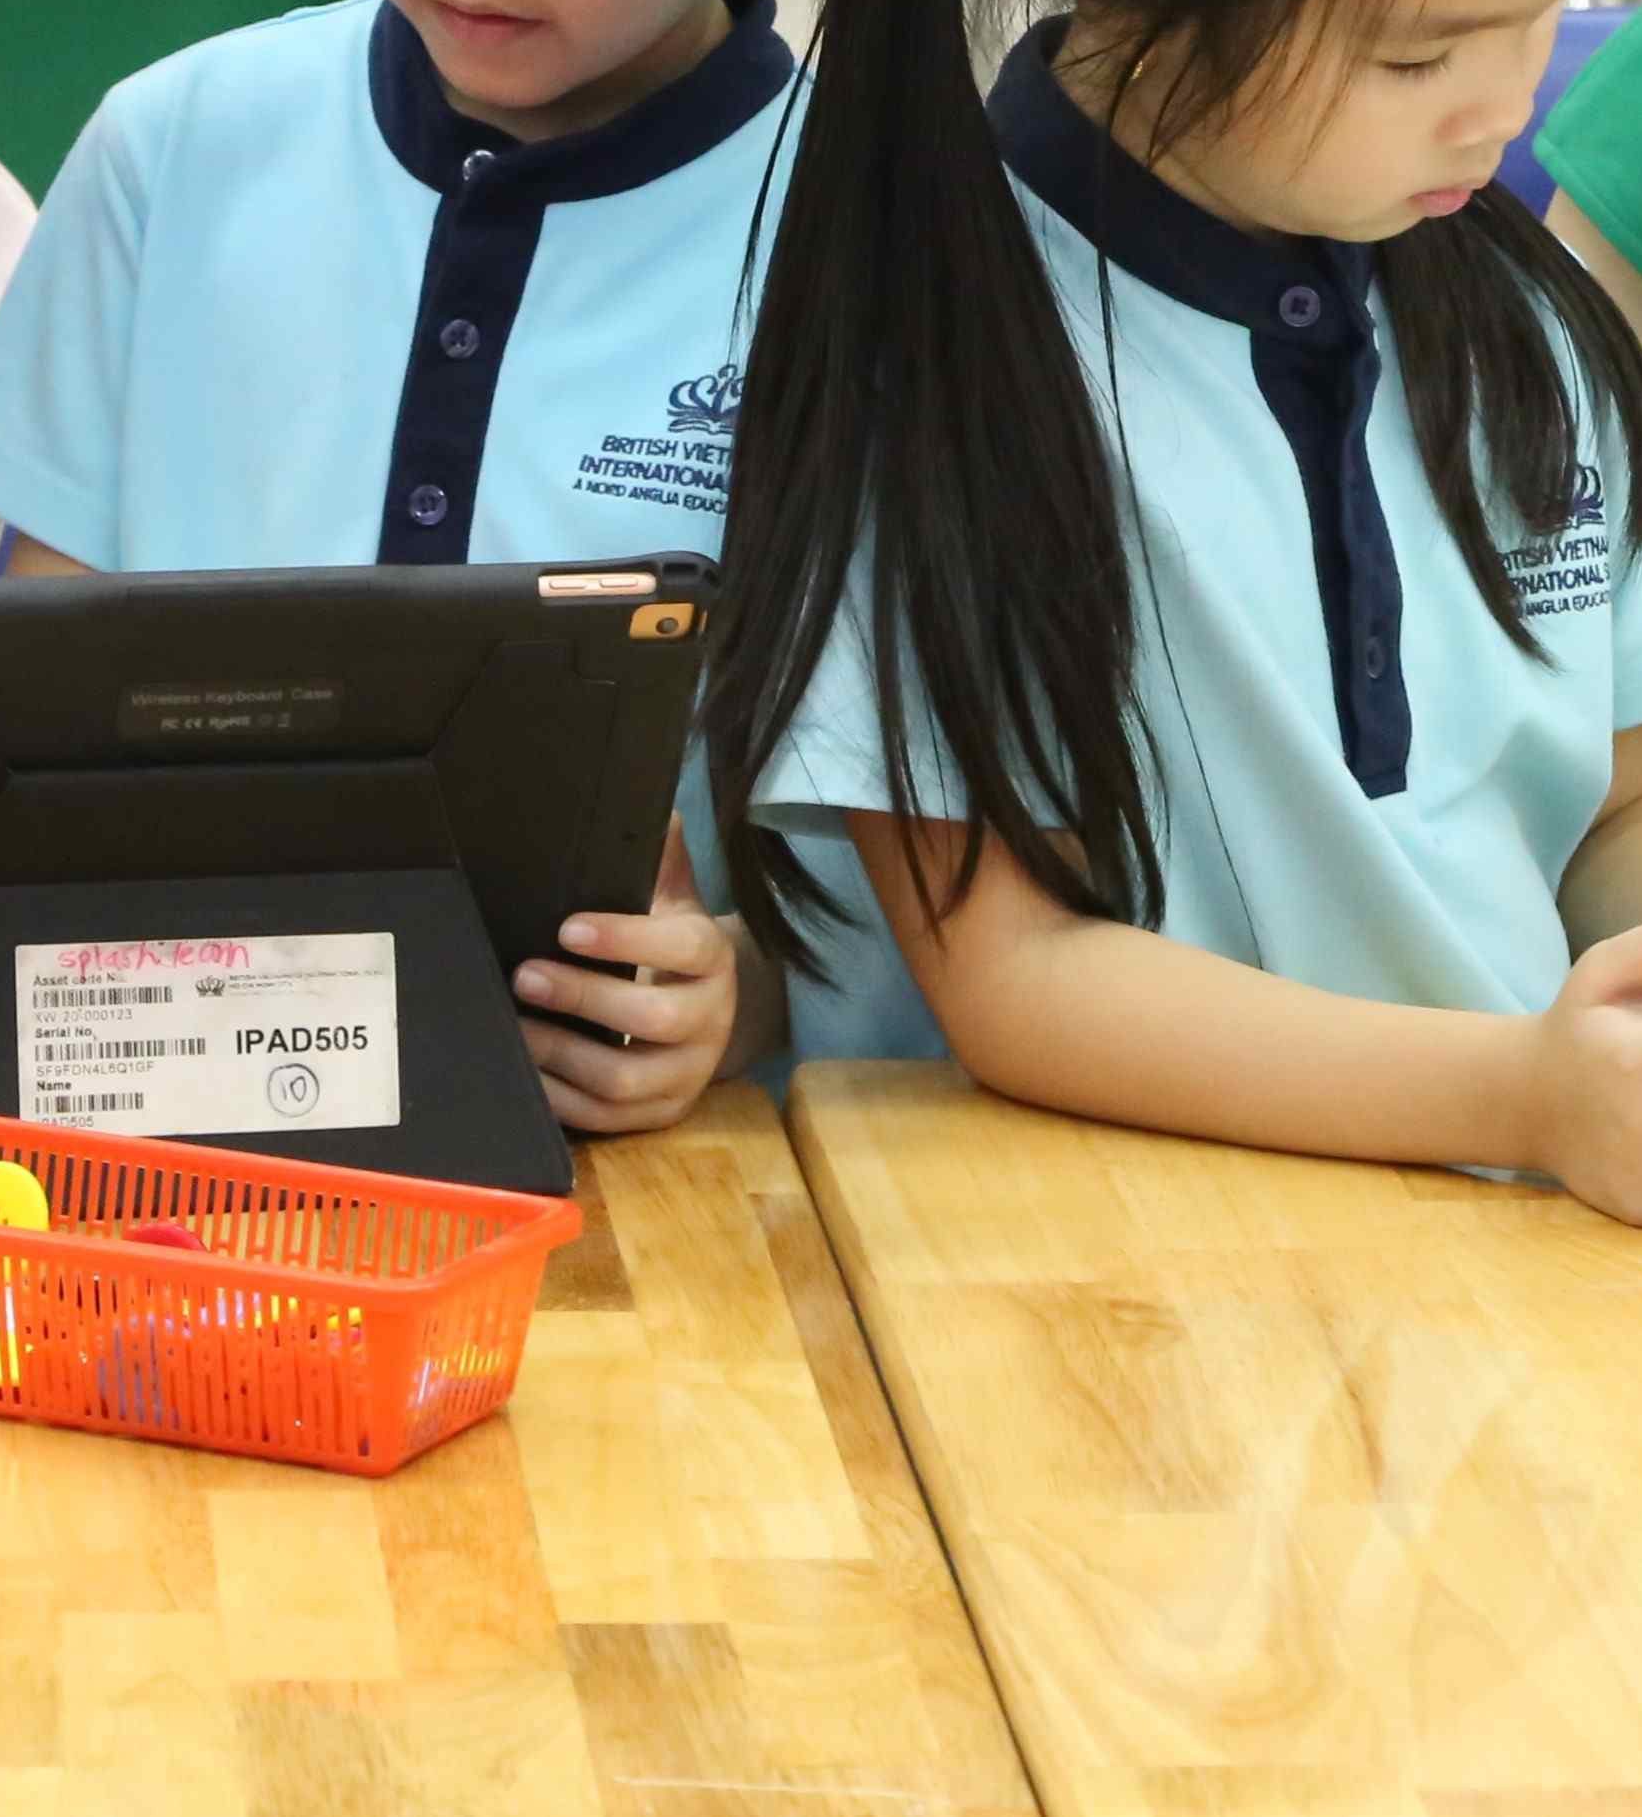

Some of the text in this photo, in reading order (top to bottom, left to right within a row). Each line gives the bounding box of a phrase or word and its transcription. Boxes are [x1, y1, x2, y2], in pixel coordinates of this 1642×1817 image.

[601, 435, 732, 466] BRITISH VIET
[579, 455, 729, 495] INTERNATIONA
[572, 478, 582, 490] A
[585, 480, 626, 498] NORD
[682, 494, 727, 515] EDUC
[1557, 536, 1609, 562] VIETNA
[57, 939, 252, 982] splash team
[35, 1027, 71, 1039] Serial
[235, 1025, 369, 1056] IPAD505
[37, 1081, 72, 1091] Name
